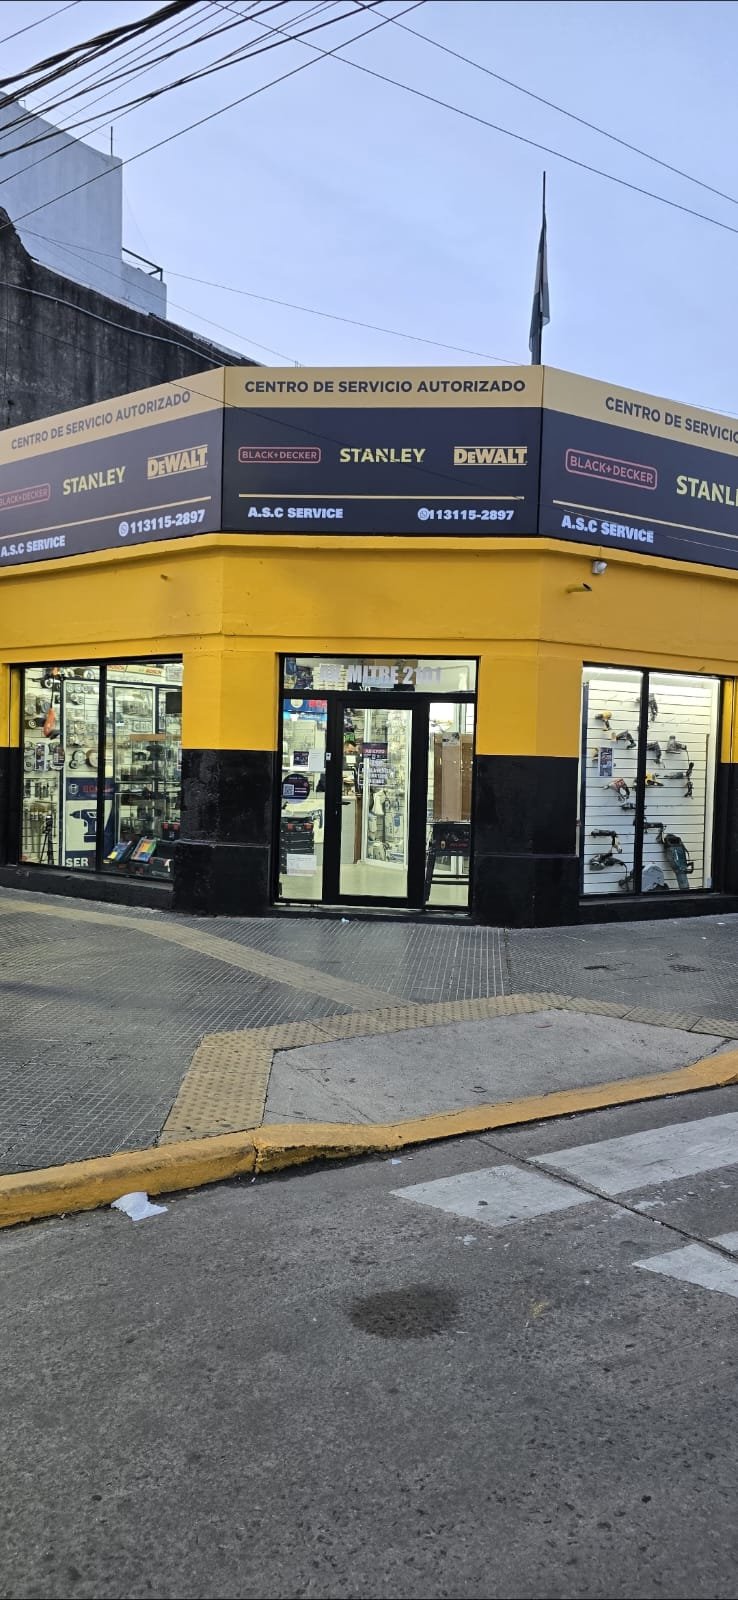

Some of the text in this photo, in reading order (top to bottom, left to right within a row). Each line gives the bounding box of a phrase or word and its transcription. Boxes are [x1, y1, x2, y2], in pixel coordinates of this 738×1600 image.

[244, 380, 526, 393] CENTRO DE SERVICIO AUTORIZADO
[11, 390, 191, 450] CENTRO DE SERVICIO AUTORIZADO
[605, 397, 661, 422] CENTRO
[664, 413, 682, 428] DE
[241, 450, 317, 460] BLACK+DECKER
[339, 448, 426, 463] STANLEY
[570, 455, 654, 484] BLACK+DECKER
[62, 466, 126, 496] STANLEY
[129, 509, 206, 534] 113115-2897
[248, 507, 343, 519] A.S.C SERVICE
[428, 509, 515, 521] 113115-2897
[561, 515, 654, 544] A.S.C SERVICE
[1, 535, 66, 557] A.S.C SERVICE
[348, 664, 399, 685] MITRE
